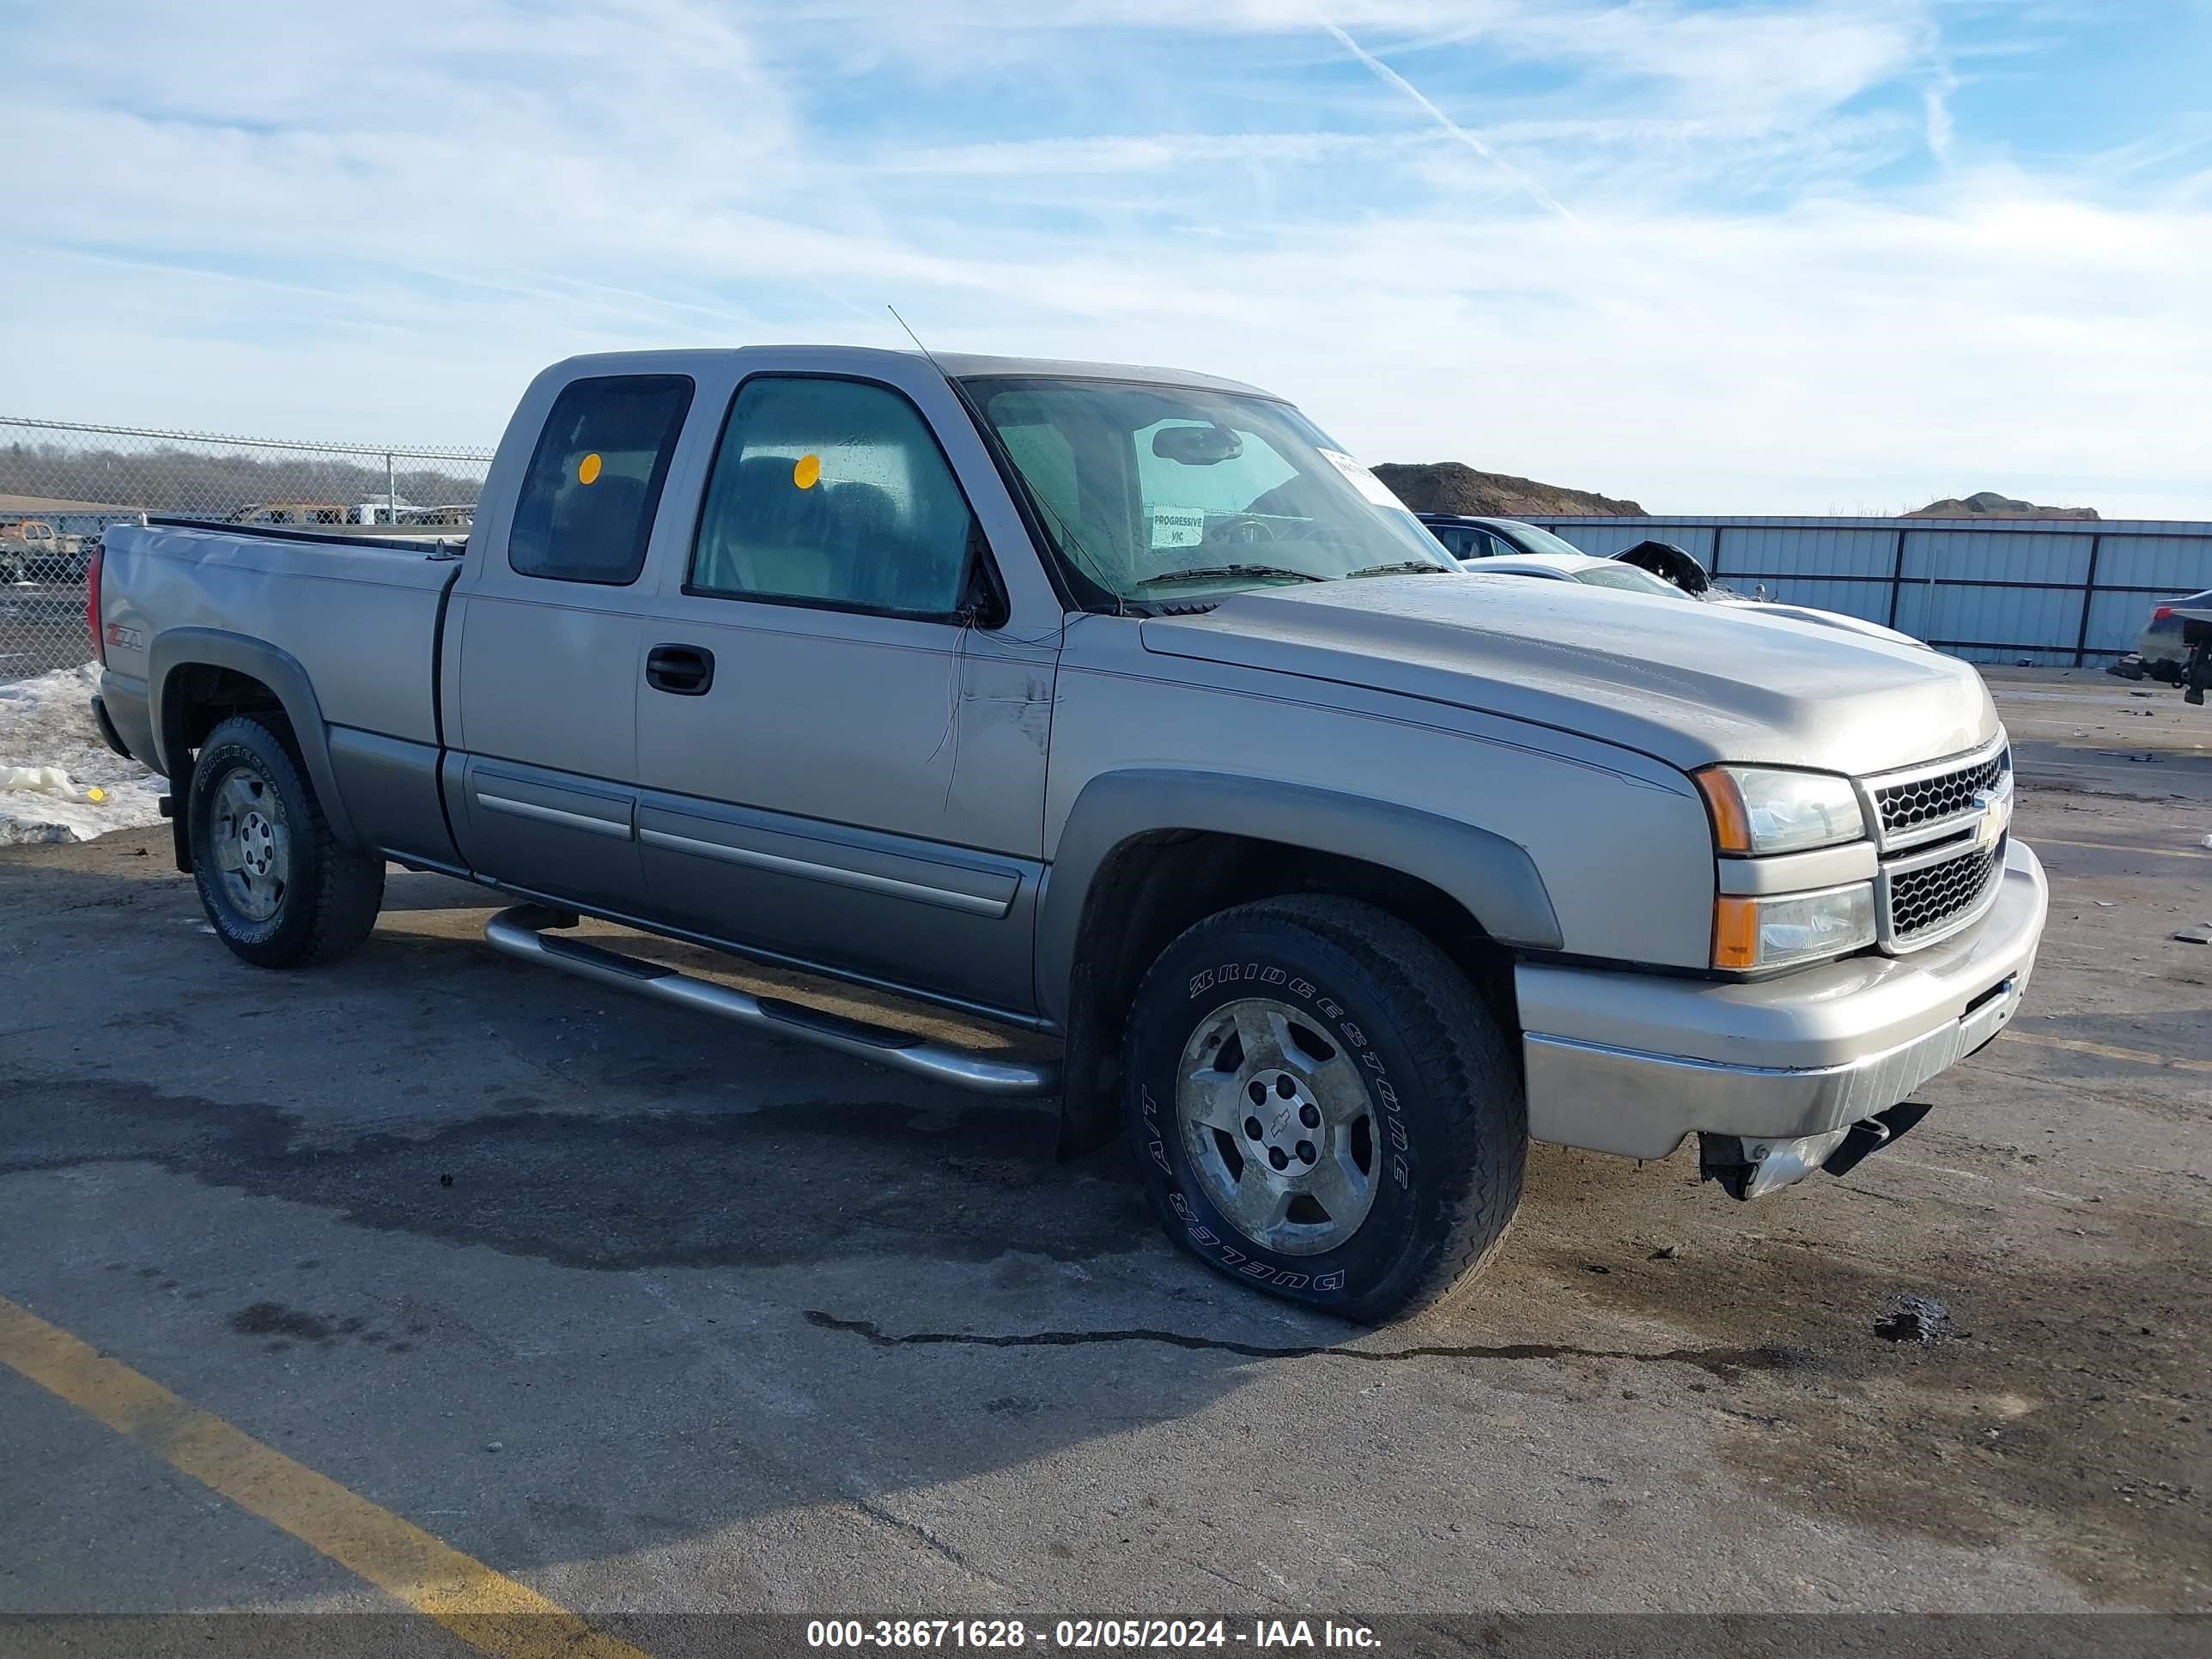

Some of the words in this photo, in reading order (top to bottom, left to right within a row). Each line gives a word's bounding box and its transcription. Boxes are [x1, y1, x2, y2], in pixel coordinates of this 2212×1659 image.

[1154, 515, 1202, 527] PROGRESSIVE
[1189, 963, 1408, 1190] BRIDGESTONE
[1141, 1084, 1173, 1176] A/T
[1170, 1194, 1346, 1291] DUELER
